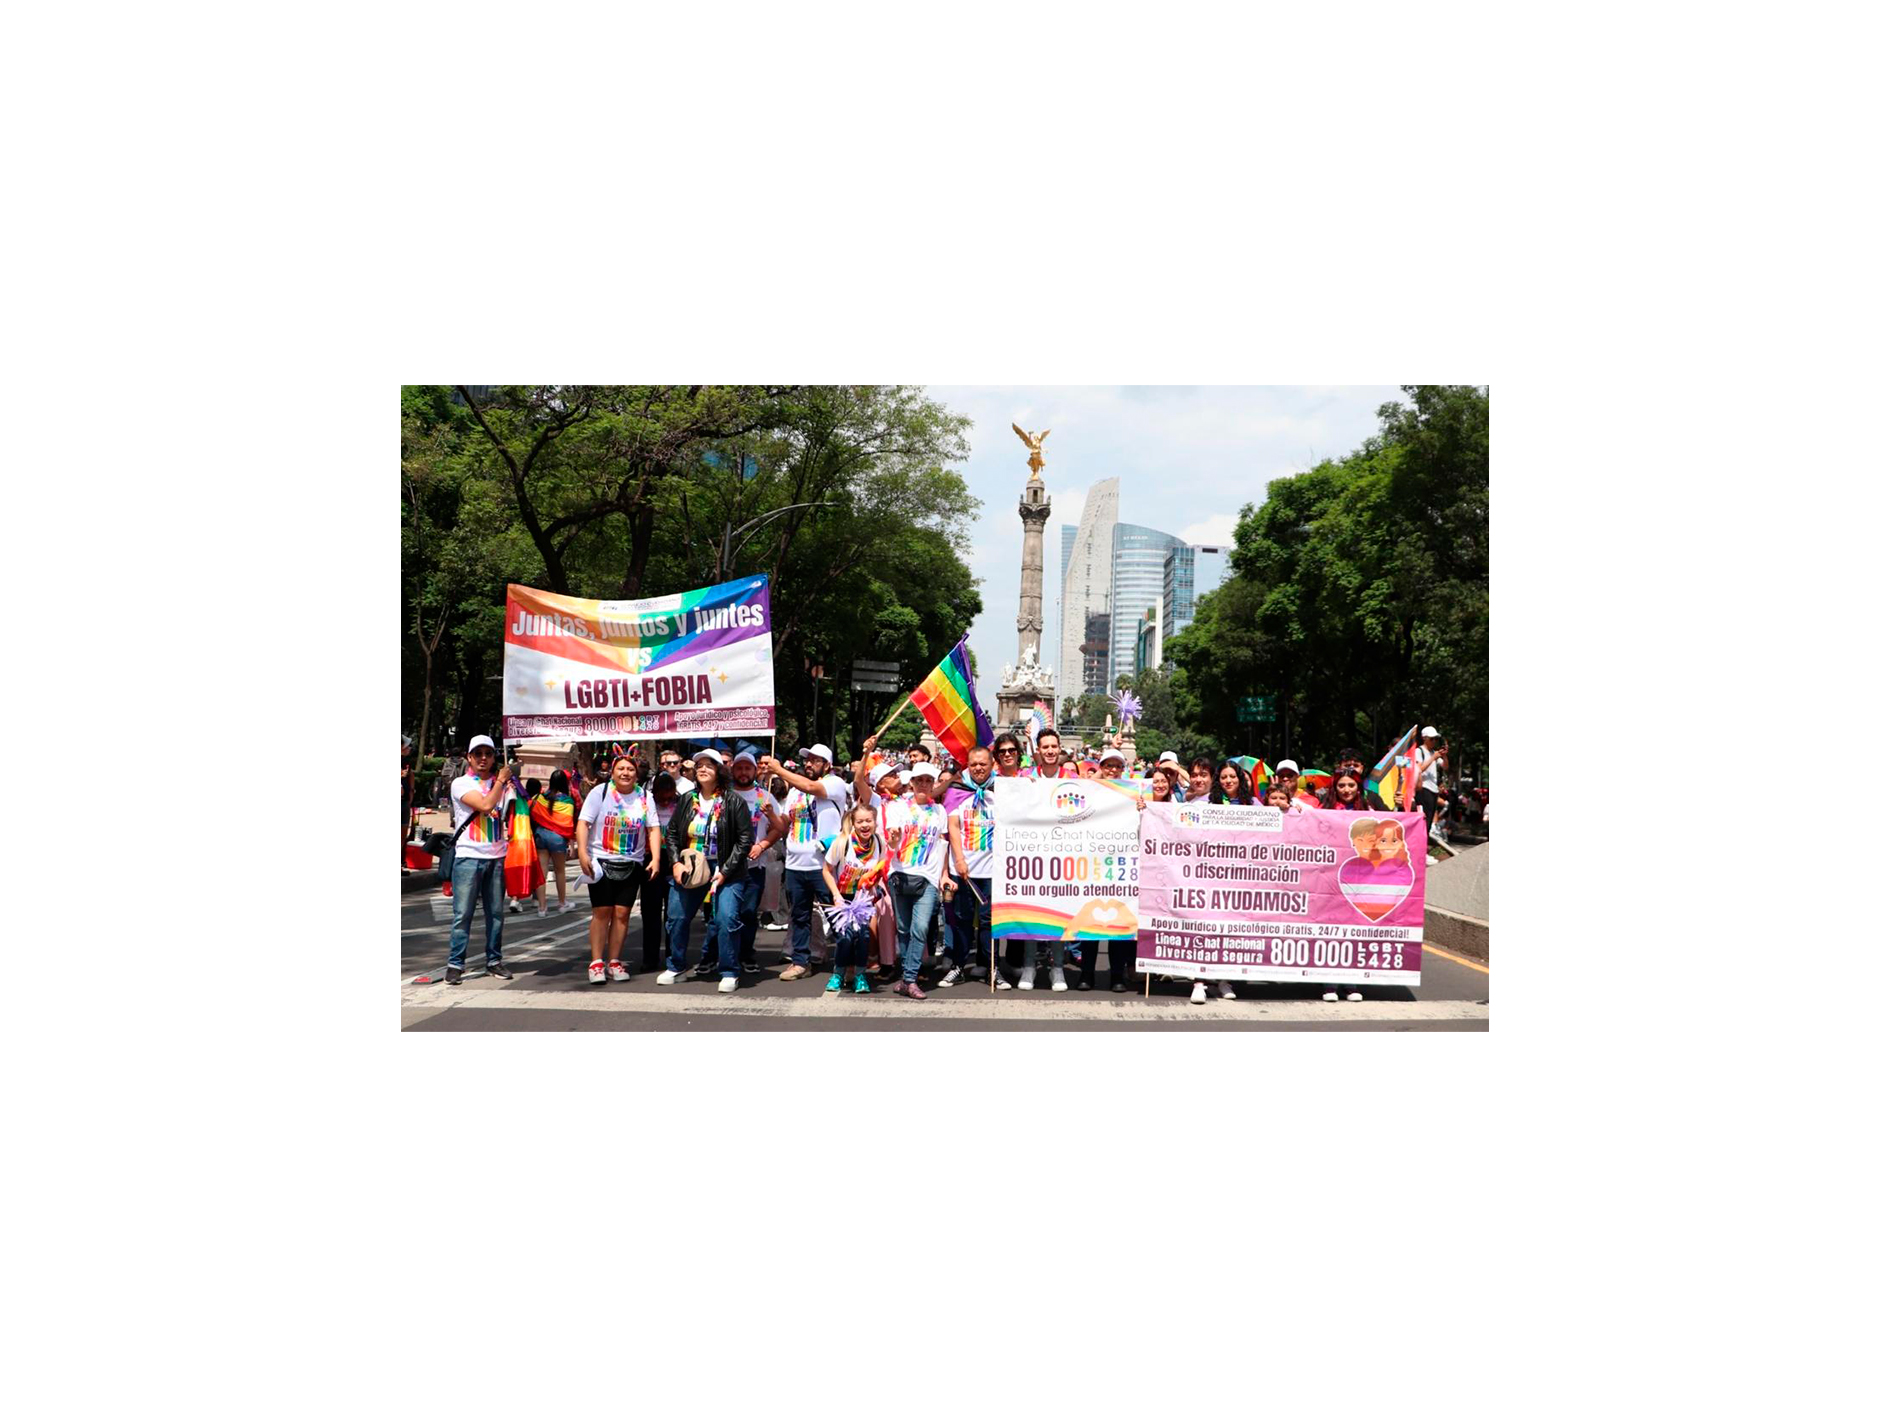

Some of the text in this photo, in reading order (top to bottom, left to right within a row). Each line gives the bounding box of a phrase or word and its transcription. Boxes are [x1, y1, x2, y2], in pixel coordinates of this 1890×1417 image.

[512, 611, 595, 640] Juntas,
[601, 616, 669, 639] juntos
[675, 613, 687, 637] y
[695, 603, 764, 634] juntes
[564, 674, 712, 709] LGBTI+FOBIA
[585, 716, 632, 732] 800 000
[1236, 810, 1280, 818] CIUDADANO
[1005, 827, 1038, 840] Línea
[1042, 832, 1048, 841] y
[1086, 829, 1140, 840] Nacional
[1005, 840, 1140, 855] Diversidad Segura
[1144, 839, 1335, 863] Si eres víctima de violencia
[1006, 856, 1088, 881] 800 000
[1183, 862, 1299, 883] o discriminación
[1005, 883, 1139, 898] Es un orgullo atenderte
[1173, 888, 1307, 913] ¡LES AYUDAMOS!
[1151, 918, 1410, 939] Apoyo jurídico y psicológico ¡Gratis, 24/7 y confidencial!
[1155, 932, 1182, 946] Línea
[1184, 938, 1190, 948] y
[1222, 937, 1265, 950] Nacional
[1155, 945, 1263, 964] Diversidad Segura
[1271, 938, 1353, 967] 800 000
